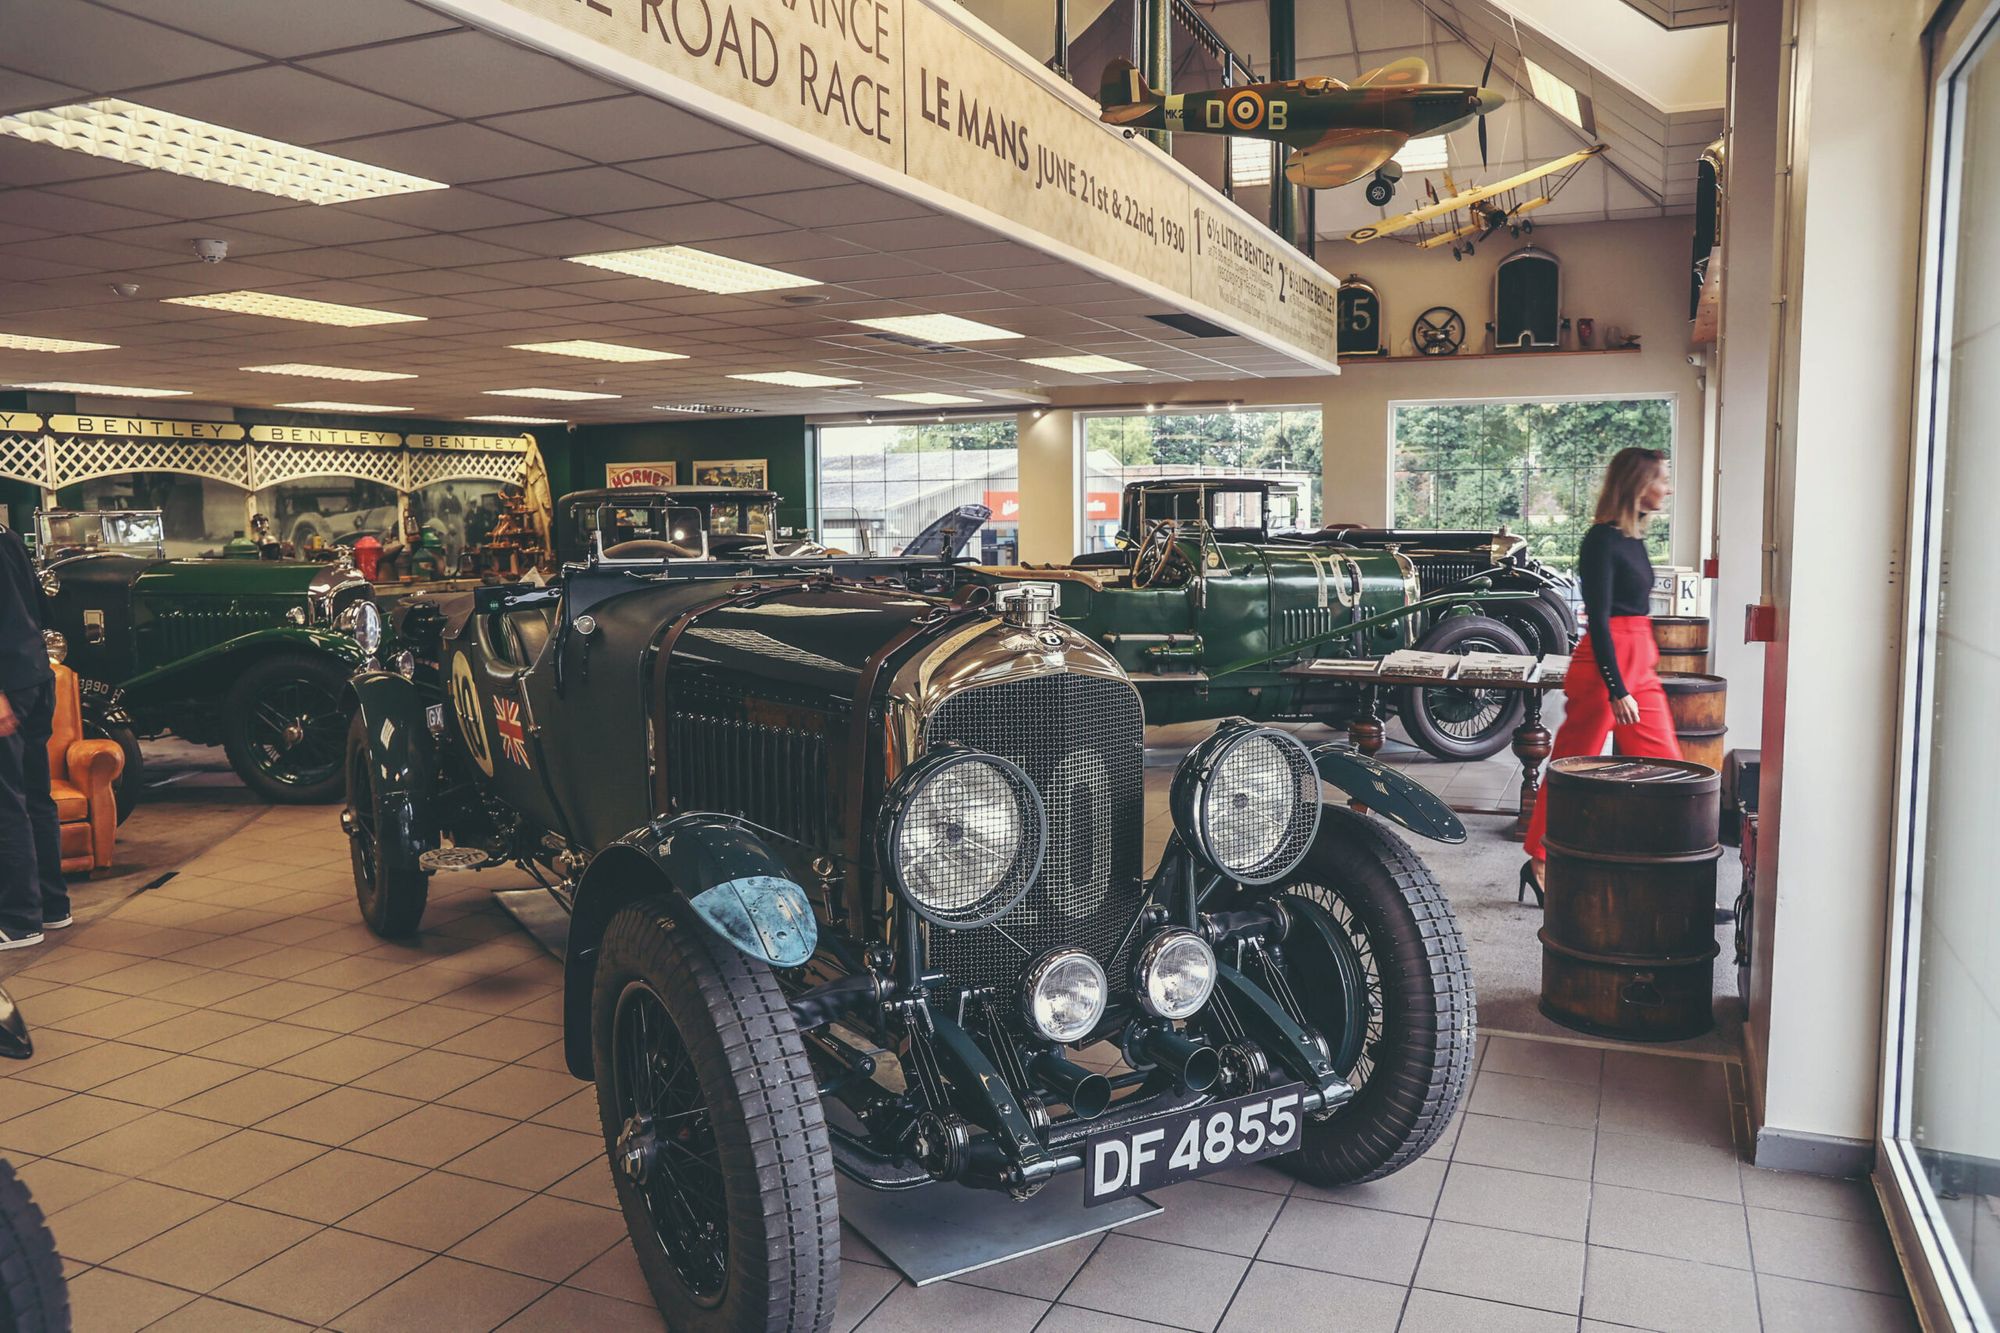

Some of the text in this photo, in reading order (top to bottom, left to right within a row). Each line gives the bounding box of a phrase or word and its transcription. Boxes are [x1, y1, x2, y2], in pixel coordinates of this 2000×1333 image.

[800, 43, 890, 144] RACE
[1206, 100, 1288, 130] D B
[920, 67, 1185, 253] LE MANS JUNE 21st & 22nd, 1930
[1221, 223, 1243, 258] LITRE
[1244, 239, 1274, 277] BENTLEY
[78, 417, 223, 438] BENTLEY
[271, 427, 386, 445] BENTLEY
[423, 436, 517, 450] BENTLEY
[611, 469, 670, 487] HORNET
[1681, 580, 1695, 599] K
[1094, 1094, 1299, 1197] DF 4855
